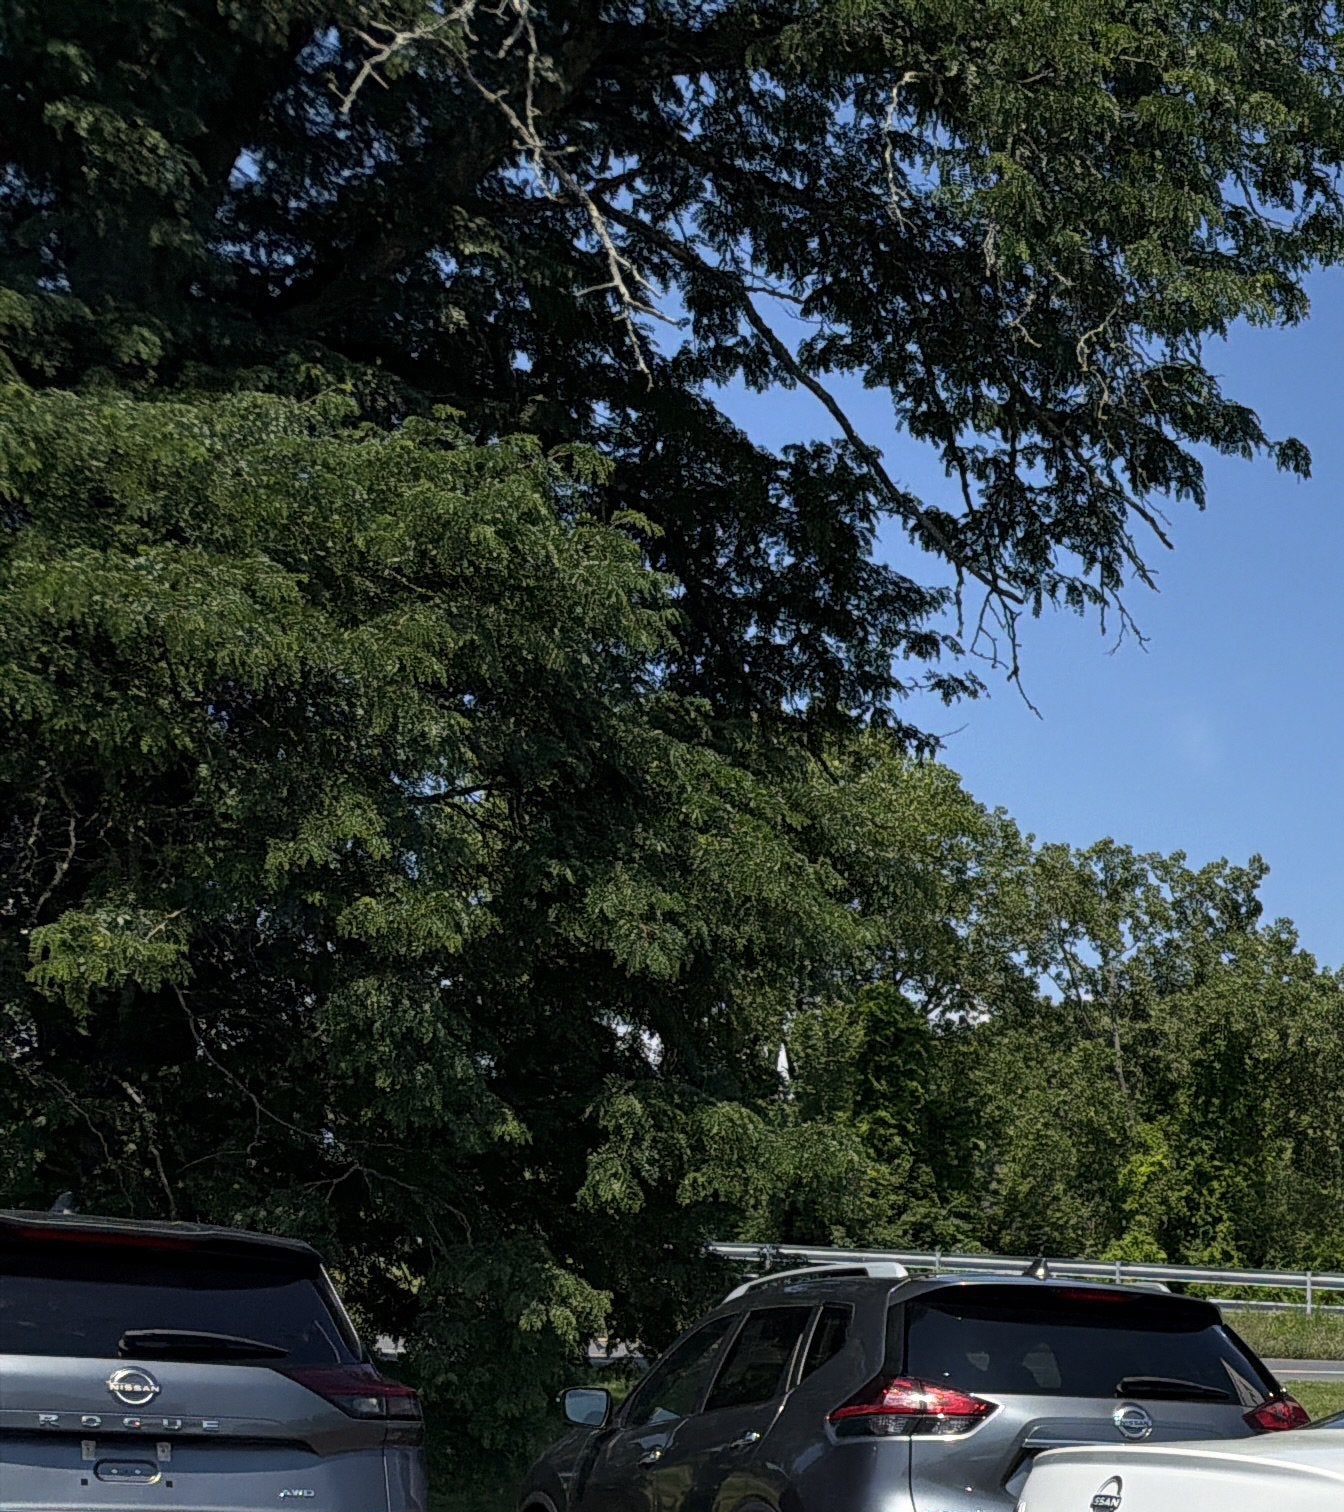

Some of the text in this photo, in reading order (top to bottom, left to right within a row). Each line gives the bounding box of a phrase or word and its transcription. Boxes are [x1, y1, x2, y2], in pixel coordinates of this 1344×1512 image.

[108, 1382, 160, 1393] NISSAN
[38, 1413, 220, 1432] ROGUE
[280, 1488, 315, 1498] AWD
